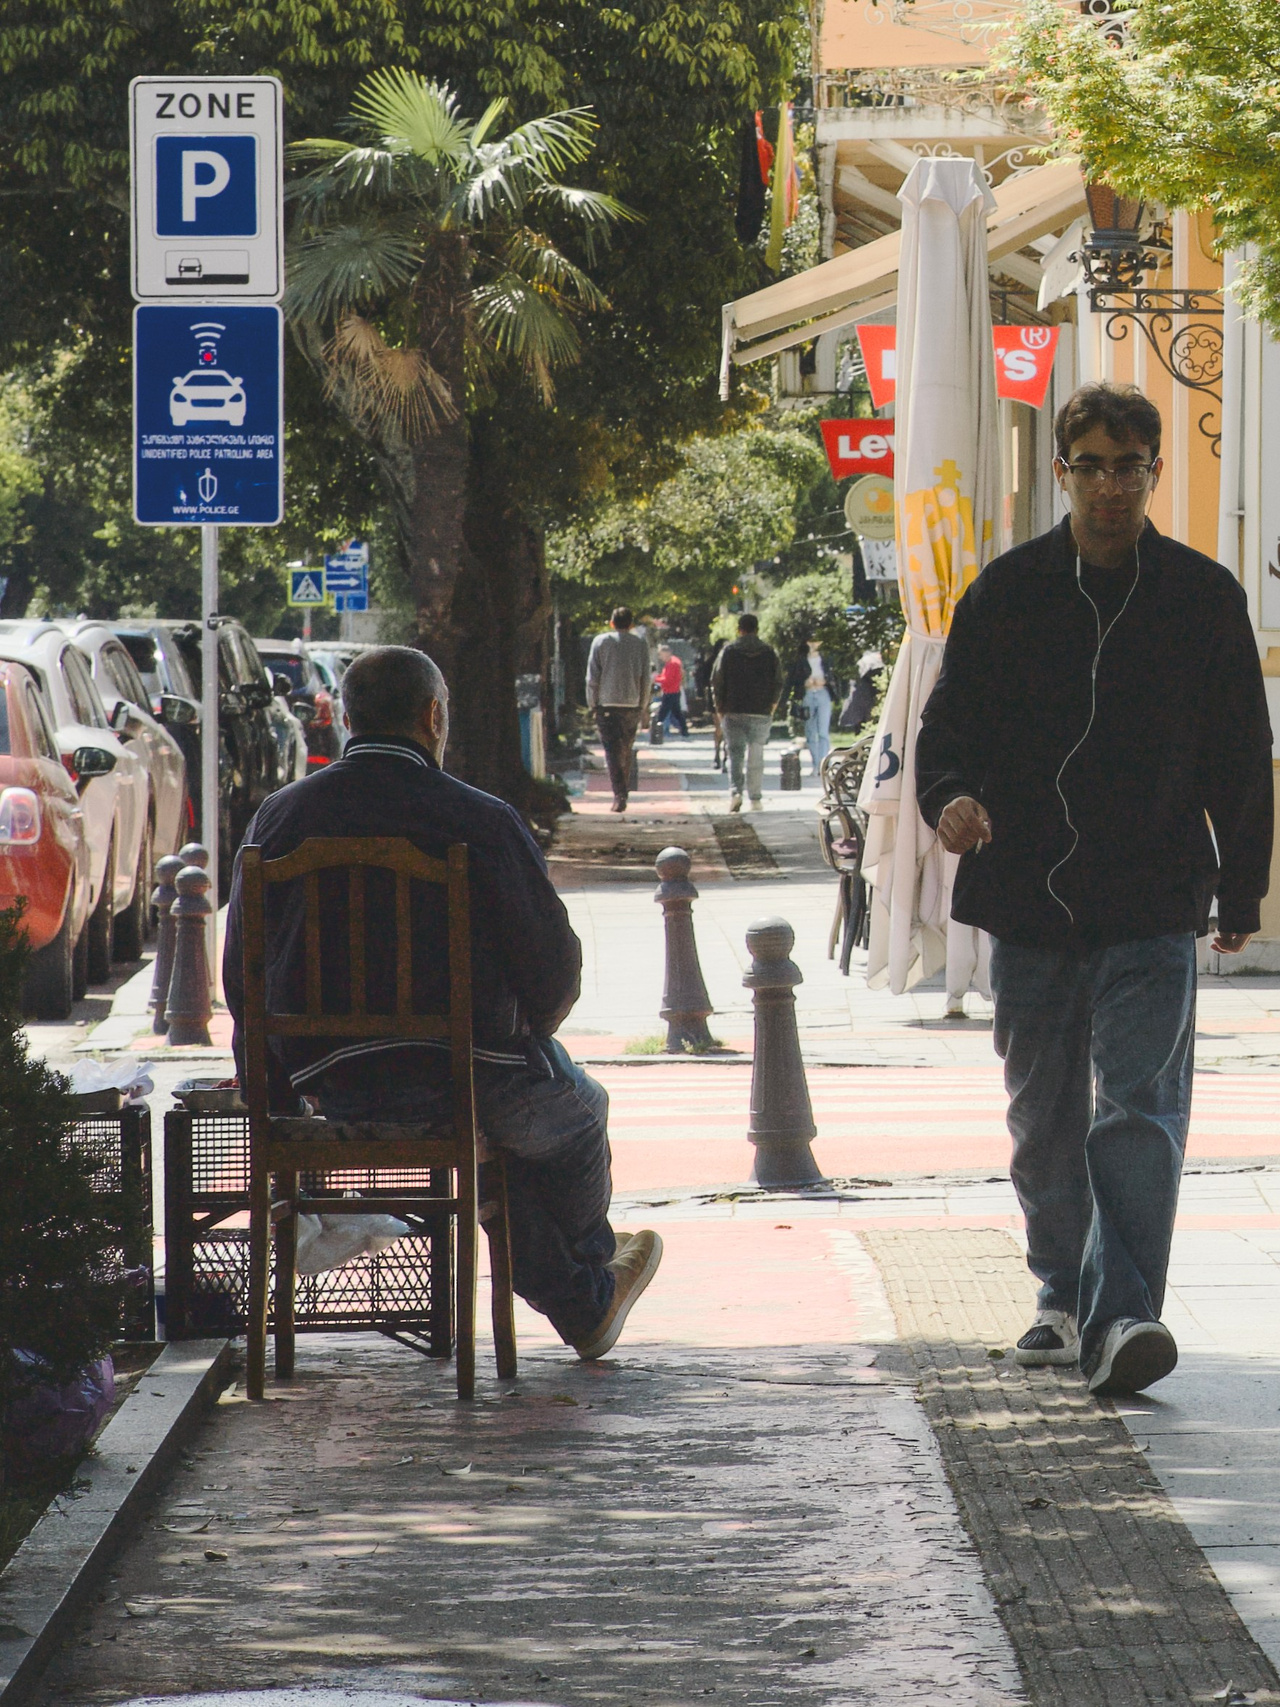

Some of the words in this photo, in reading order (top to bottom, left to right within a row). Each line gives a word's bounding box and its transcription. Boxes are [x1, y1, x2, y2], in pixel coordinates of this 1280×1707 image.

[156, 93, 255, 119] ZONE
[182, 150, 231, 222] P
[141, 449, 188, 459] UNIDENTIFIED
[189, 449, 212, 459] POLICE
[214, 449, 253, 459] PATROLLING
[256, 449, 274, 459] AREA
[172, 505, 239, 515] WWW.POLICE.GE
